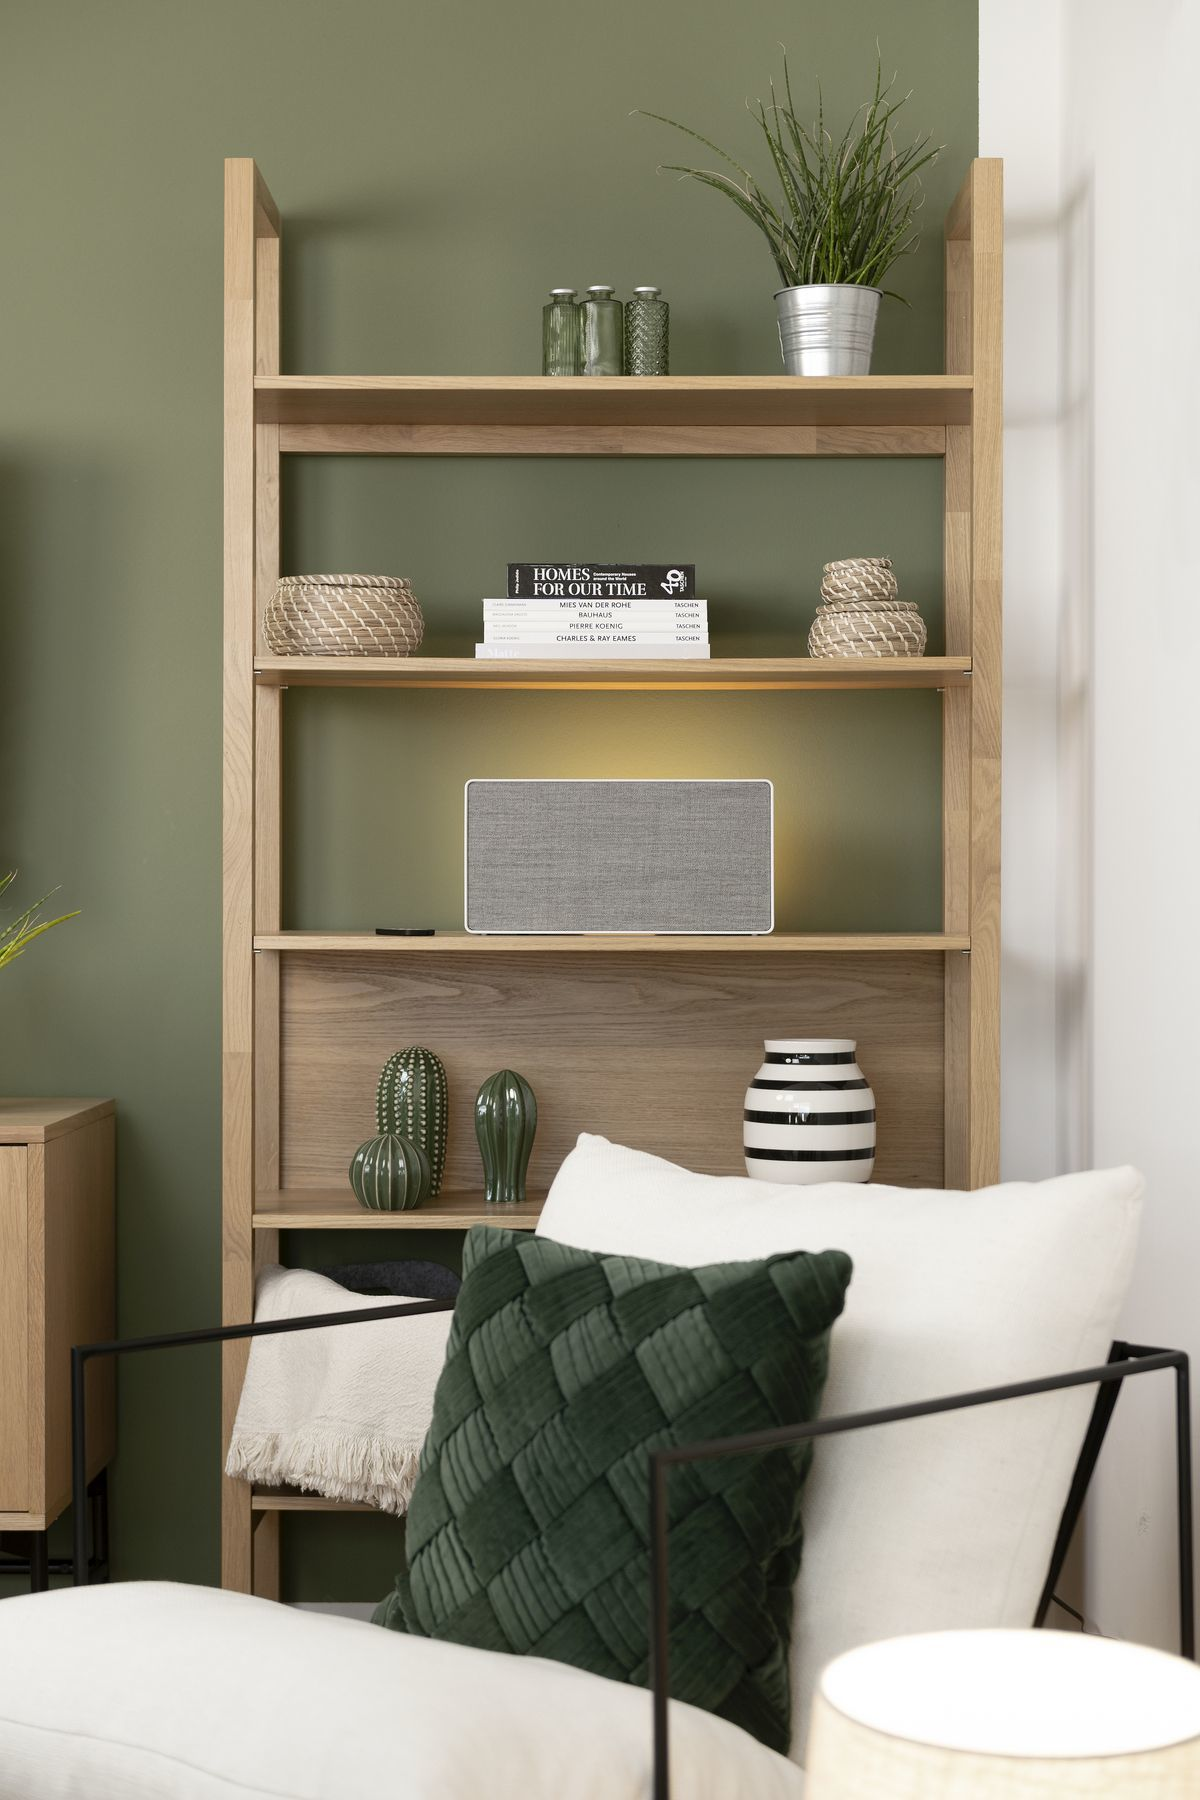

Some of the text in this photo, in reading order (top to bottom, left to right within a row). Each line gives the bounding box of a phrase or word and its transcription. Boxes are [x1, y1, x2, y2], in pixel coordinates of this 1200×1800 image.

[533, 568, 590, 580] HOMES
[533, 582, 646, 596] FOR OUR TIME
